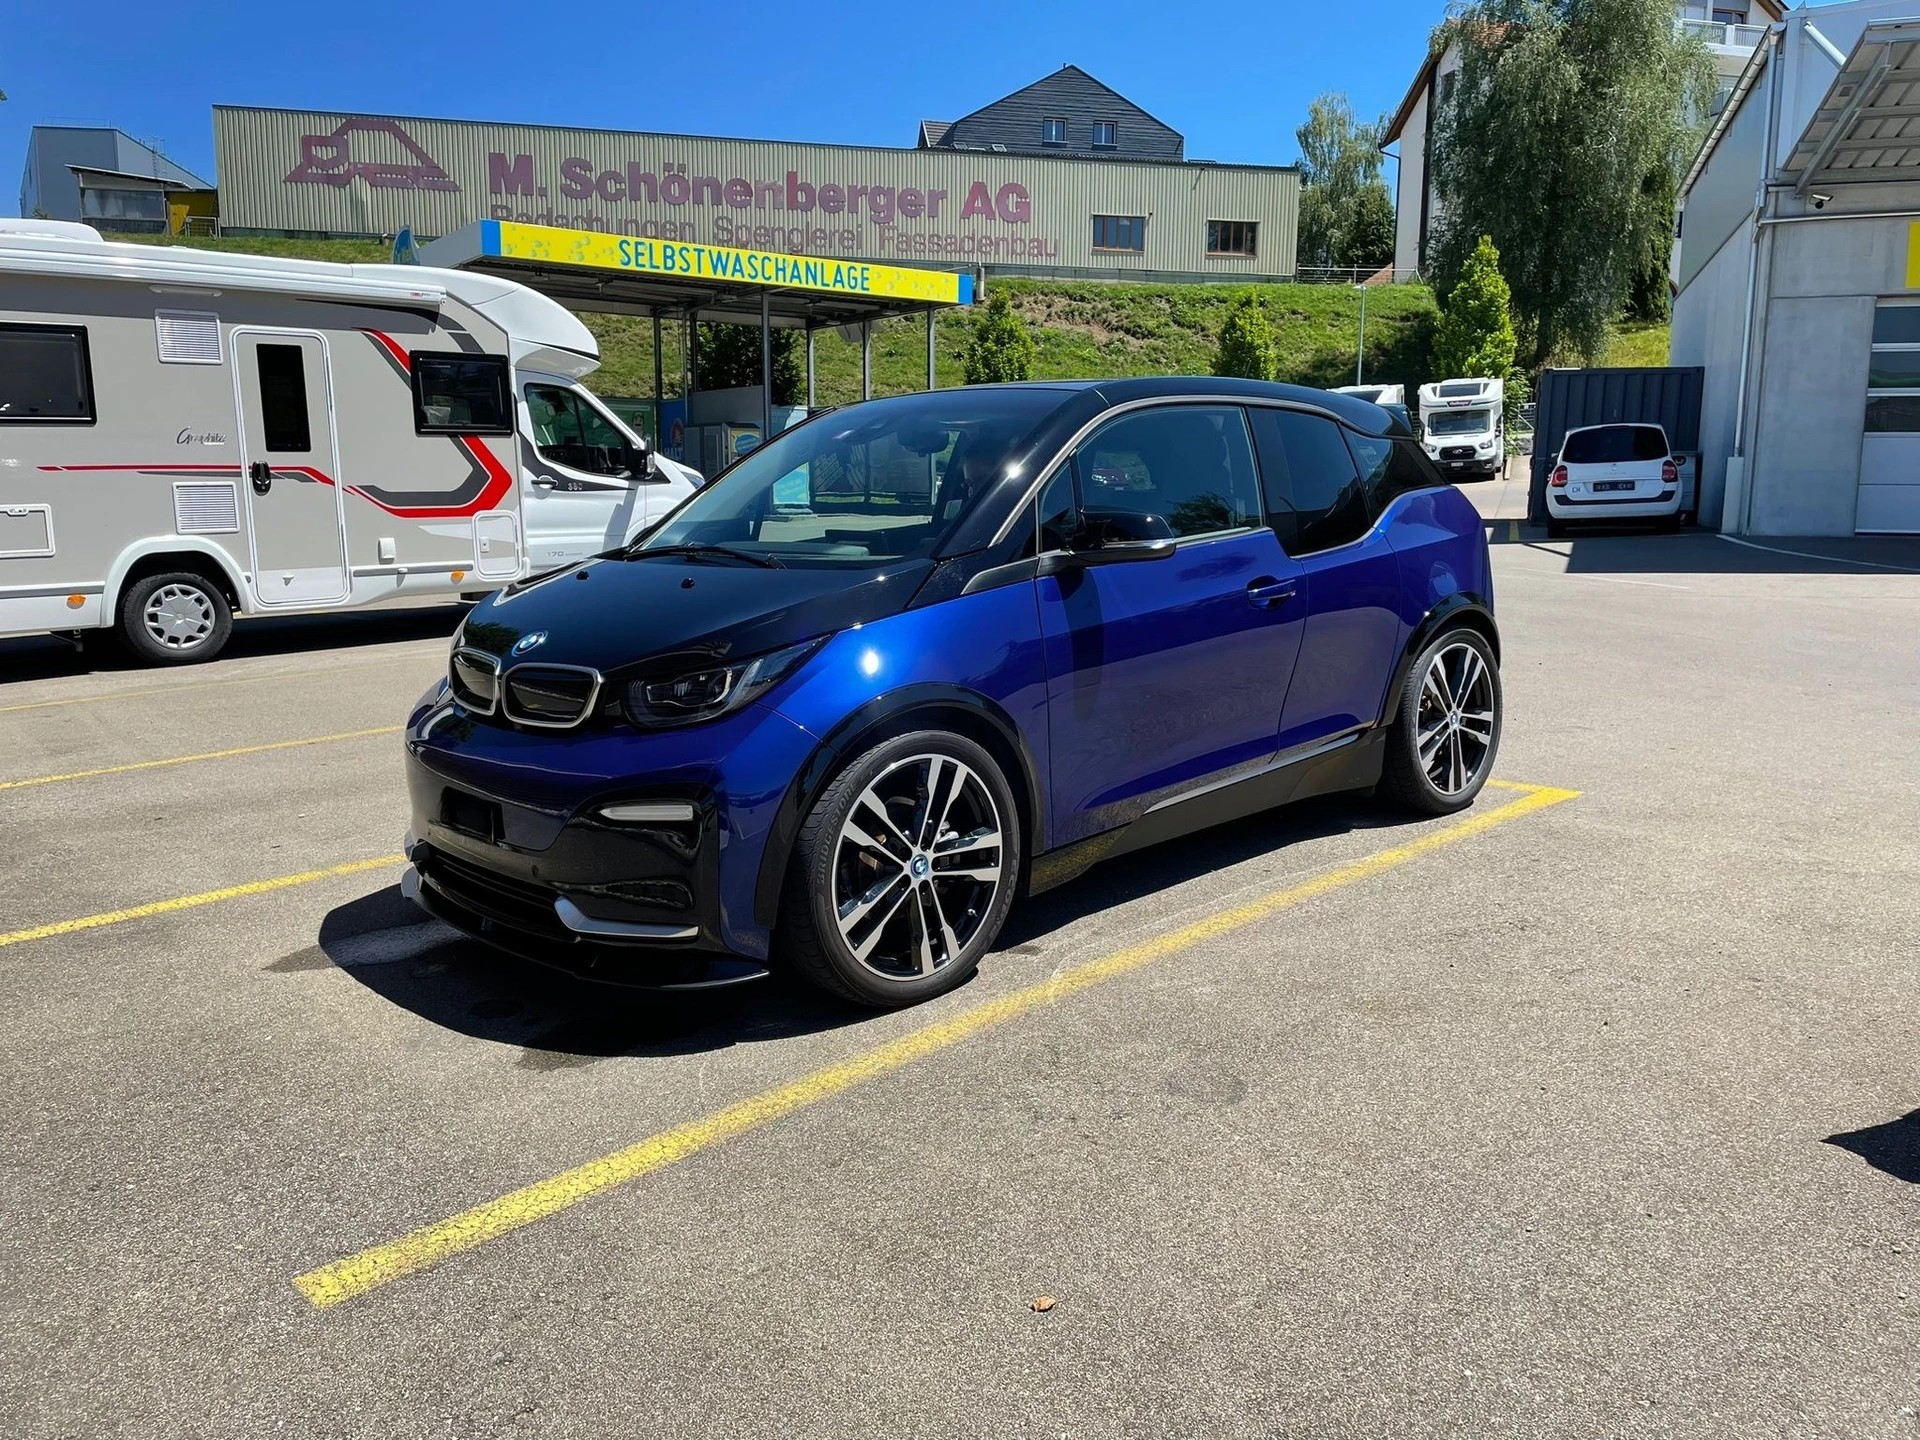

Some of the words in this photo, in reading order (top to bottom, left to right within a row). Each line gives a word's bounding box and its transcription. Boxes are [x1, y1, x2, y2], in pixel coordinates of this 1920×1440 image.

[489, 152, 548, 197] M.
[560, 157, 947, 224] Schönenberger
[960, 181, 1031, 223] AG
[713, 216, 863, 254] Spenglerei
[878, 224, 1058, 258] Fassadenbau
[618, 239, 870, 292] SELBSTWASCHANLAGE
